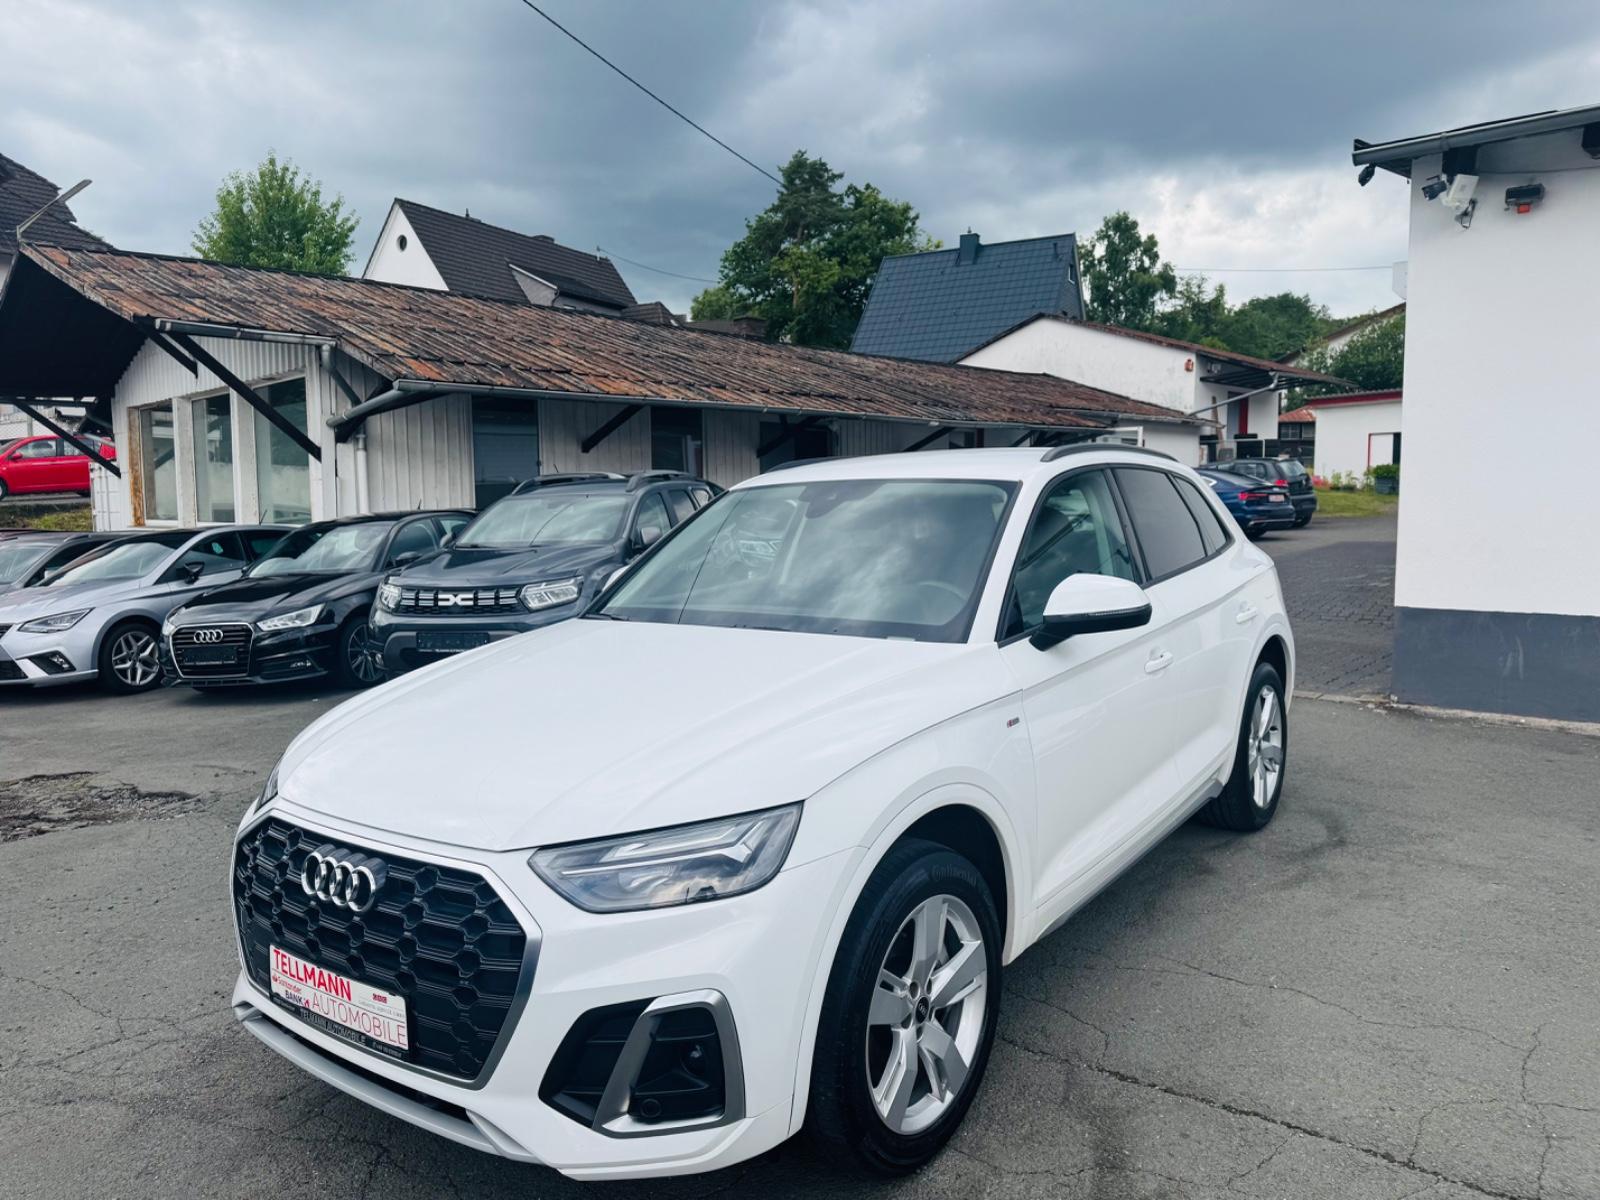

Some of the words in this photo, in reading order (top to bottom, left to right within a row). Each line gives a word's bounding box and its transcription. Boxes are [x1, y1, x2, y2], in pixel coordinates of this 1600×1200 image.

[273, 949, 352, 1002] TELLMANN
[285, 989, 304, 1006] BANK
[312, 993, 408, 1047] AUTOMOBILE
